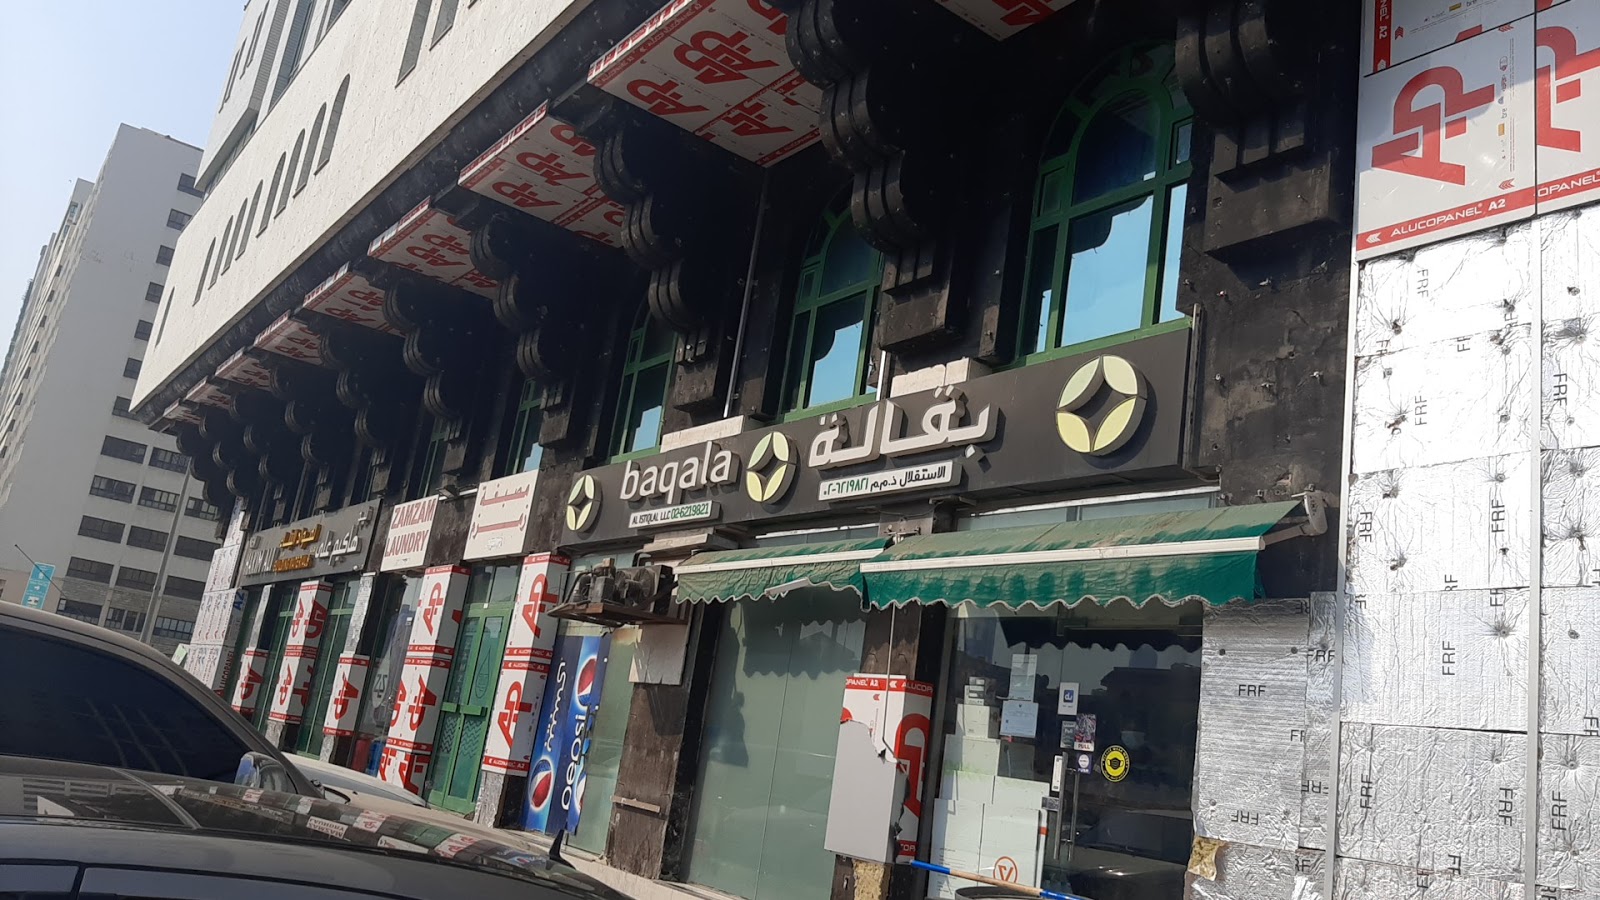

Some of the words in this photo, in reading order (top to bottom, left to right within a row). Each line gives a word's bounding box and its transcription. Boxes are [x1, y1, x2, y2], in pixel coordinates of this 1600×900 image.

[1379, 26, 1388, 40] A2
[1487, 198, 1506, 211] A2
[1417, 268, 1429, 298] FRF
[1553, 373, 1568, 407] FRF
[808, 385, 991, 468] بقالة
[1414, 395, 1427, 426] FRF
[620, 440, 732, 504] baqala
[899, 466, 947, 488] الاستقلال
[391, 498, 437, 530] ZAMZAM
[660, 510, 671, 520] LLC
[671, 502, 710, 519] 02-6219821
[1360, 511, 1373, 543] FRF
[1491, 499, 1506, 533] FRF
[384, 529, 430, 558] LAUNDRY
[1442, 640, 1456, 677] FRF
[1238, 684, 1266, 697] FRF
[1360, 773, 1374, 810] FRF
[1498, 787, 1514, 827] FRF
[1231, 811, 1260, 826] FRF
[1551, 790, 1568, 831] FRF
